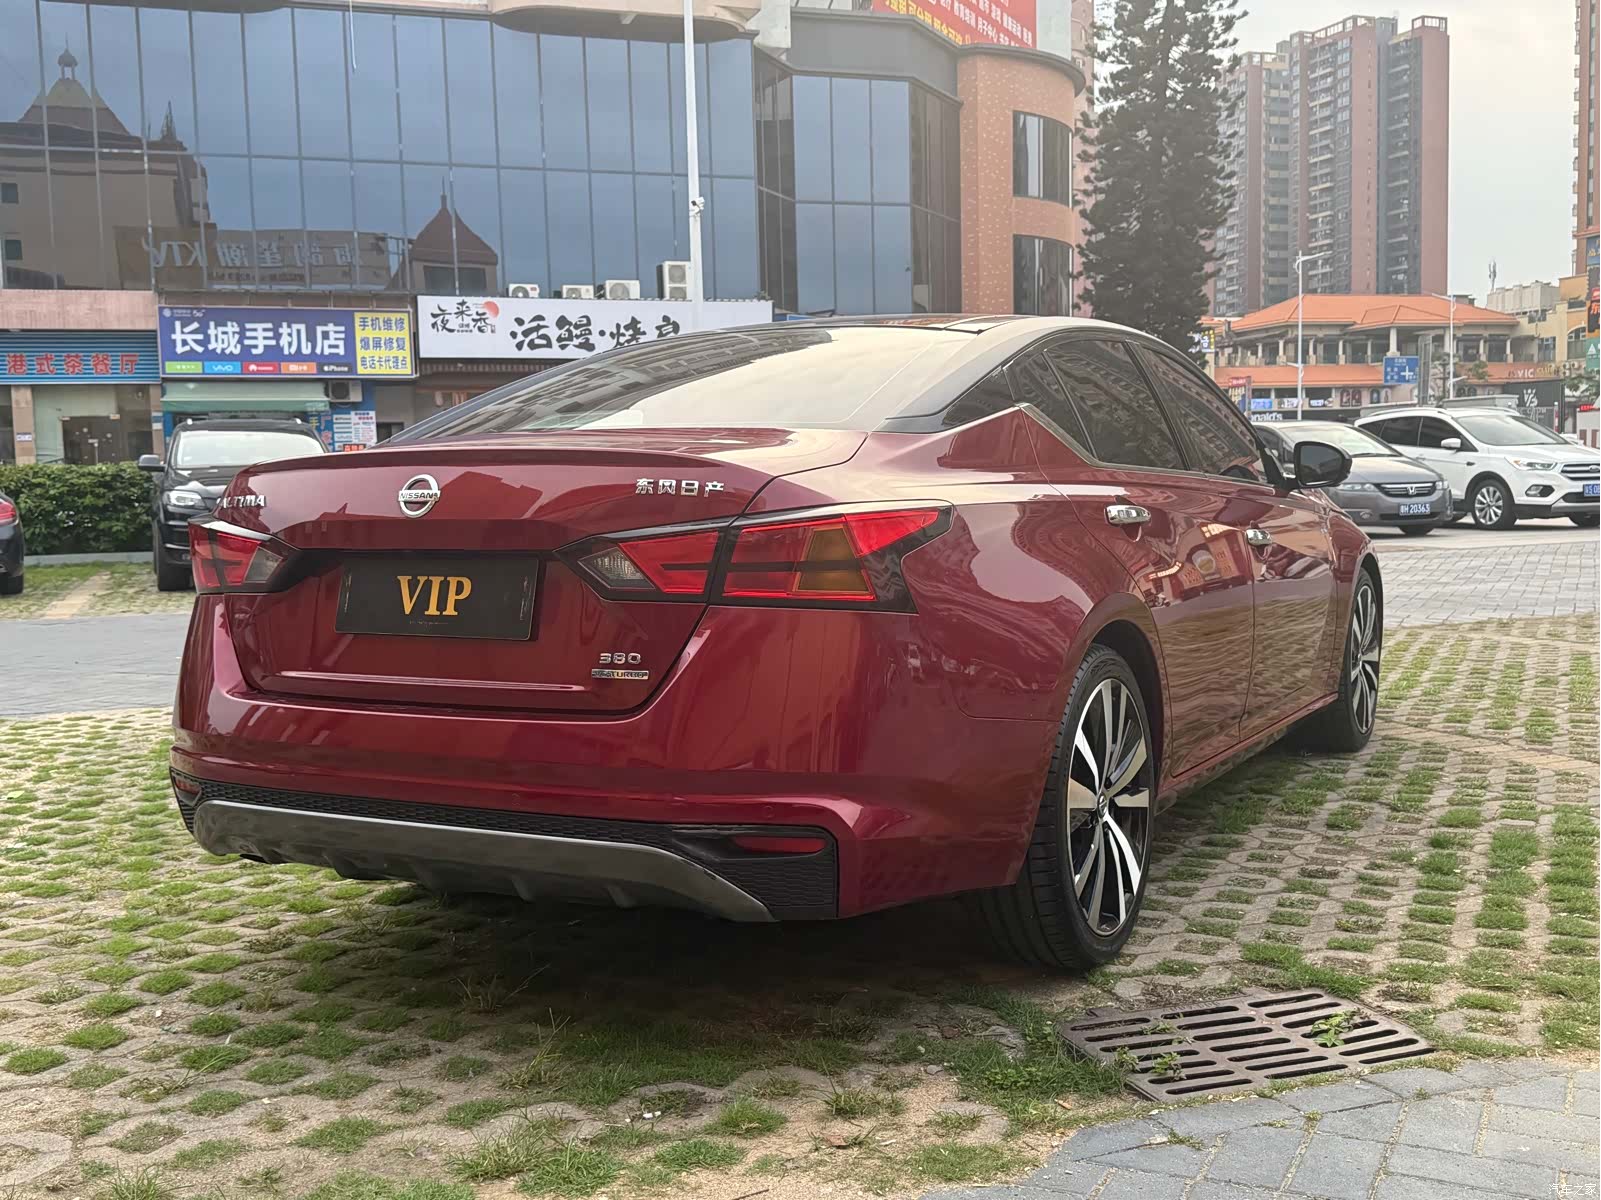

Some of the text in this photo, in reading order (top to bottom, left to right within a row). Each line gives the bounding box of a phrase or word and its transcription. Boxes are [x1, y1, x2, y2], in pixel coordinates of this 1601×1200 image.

[359, 317, 405, 331] 手机维修
[171, 320, 345, 355] 长城手机店
[360, 337, 406, 351] 爆屏修复
[6, 353, 139, 375] 港式茶餐厅
[635, 478, 725, 497] 东风日产
[397, 575, 472, 616] VIP
[599, 652, 641, 664] 380
